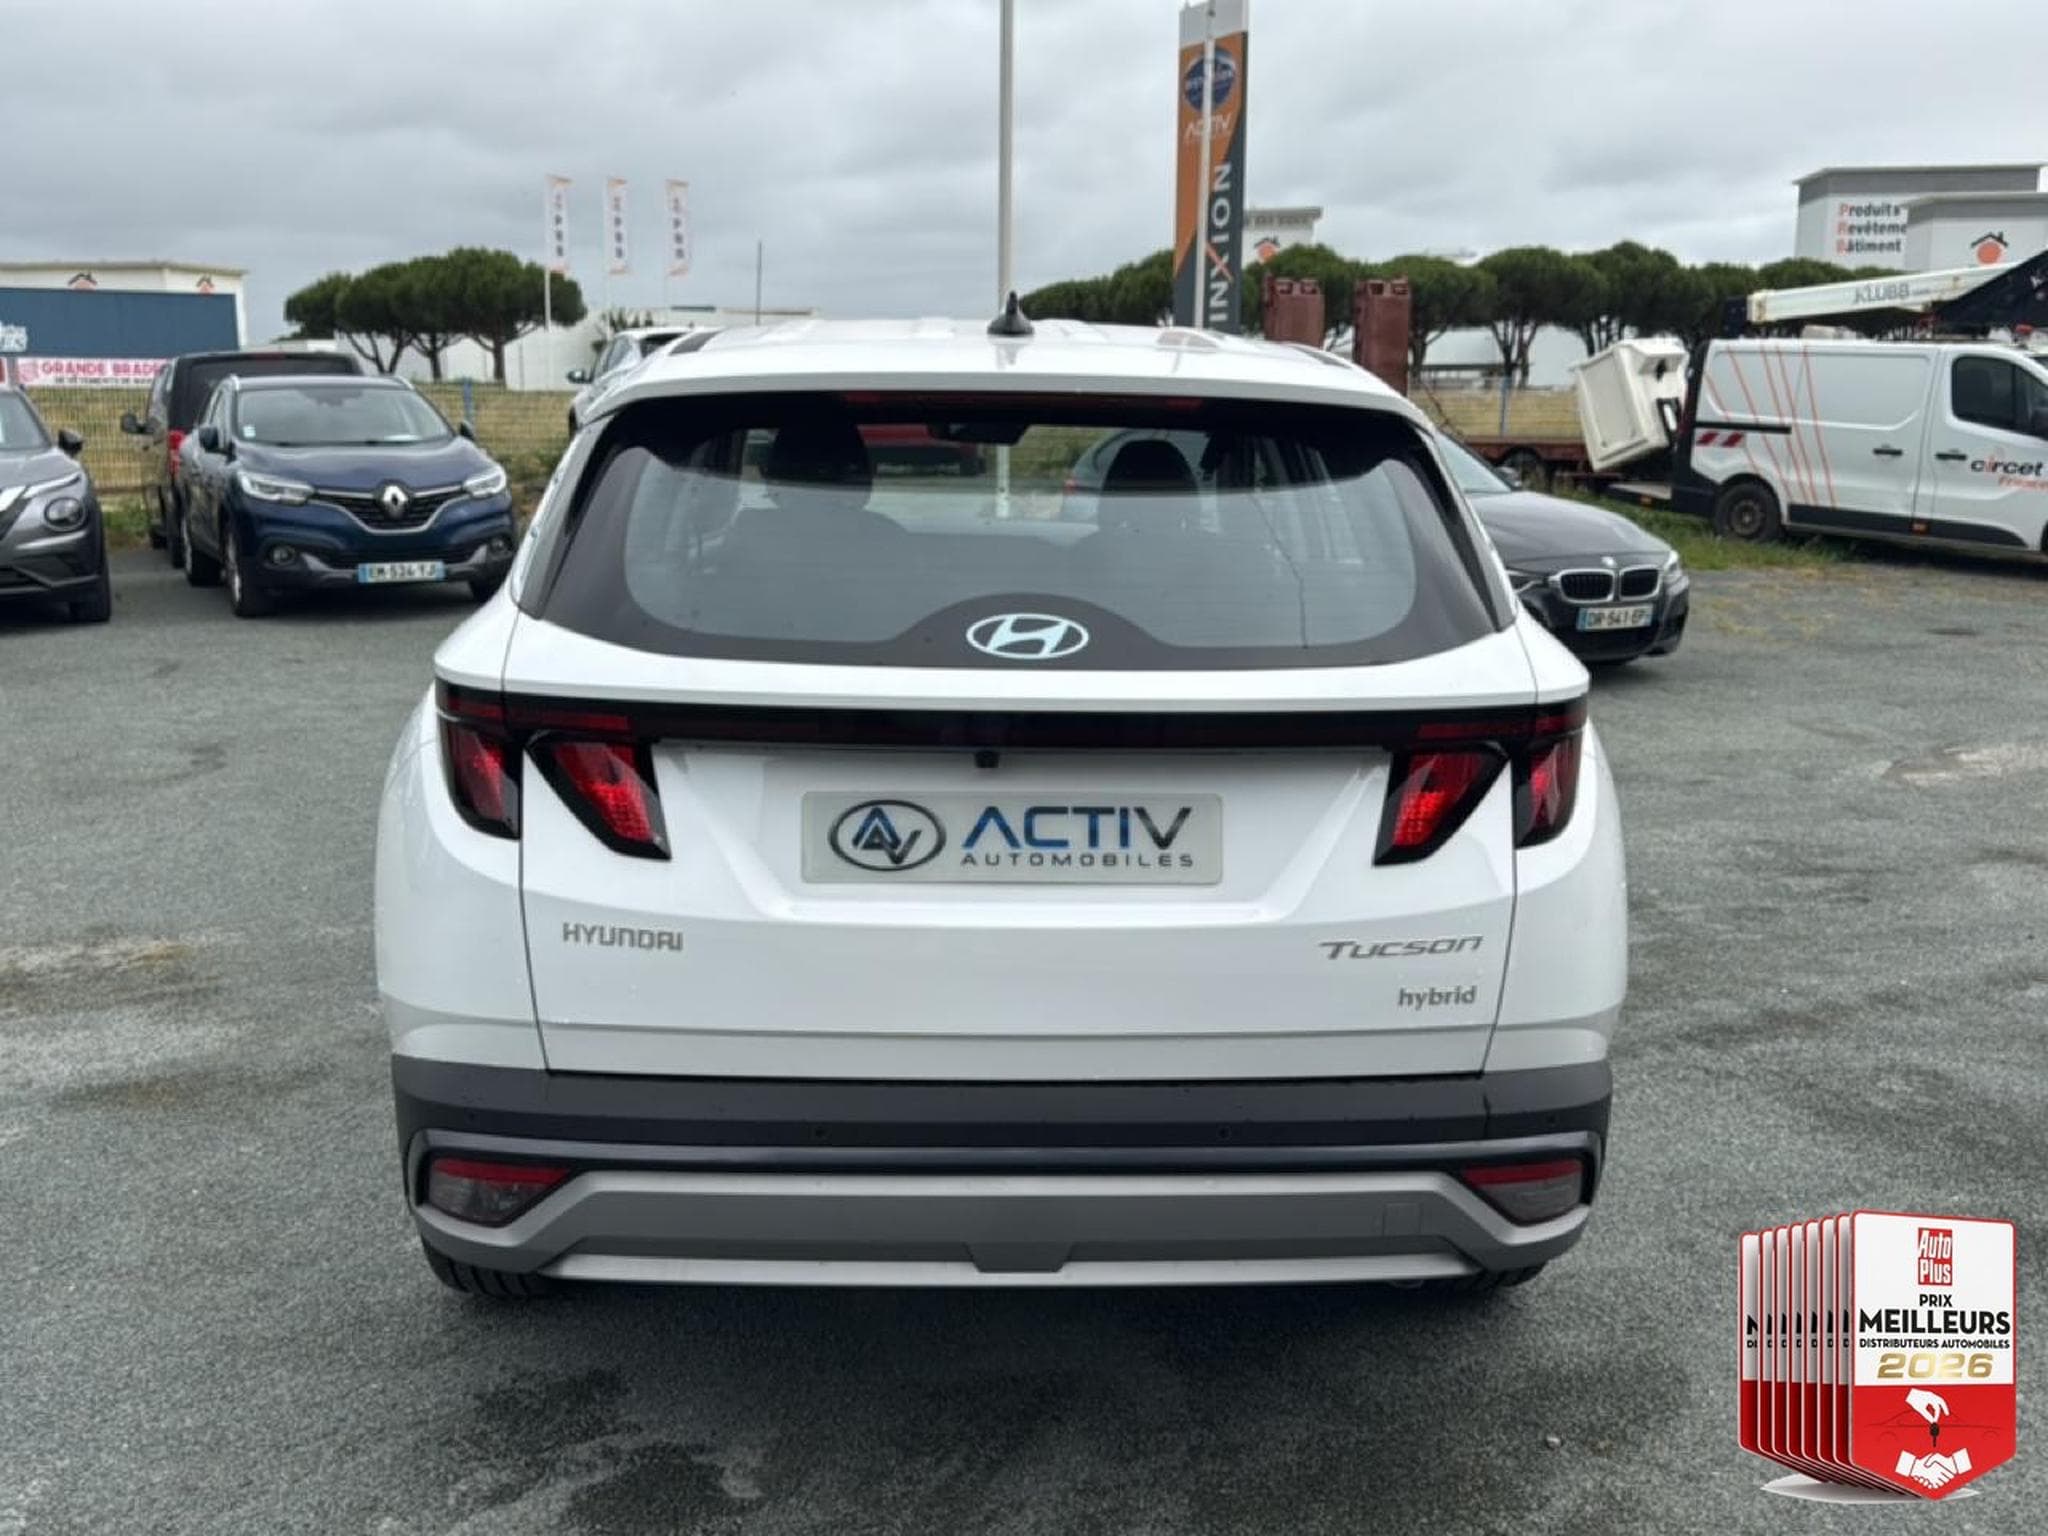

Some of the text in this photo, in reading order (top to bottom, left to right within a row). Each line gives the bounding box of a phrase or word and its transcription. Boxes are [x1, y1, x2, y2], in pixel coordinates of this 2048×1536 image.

[1840, 202, 1900, 217] Produits
[1836, 237, 1901, 254] Bâtiment
[42, 362, 104, 375] GRANDE
[1971, 456, 2043, 477] circet
[961, 806, 1193, 850] ACTIV
[960, 852, 1194, 868] AUTOMOBILES
[562, 922, 684, 951] HYUNDAI
[1397, 985, 1478, 1011] hybrid
